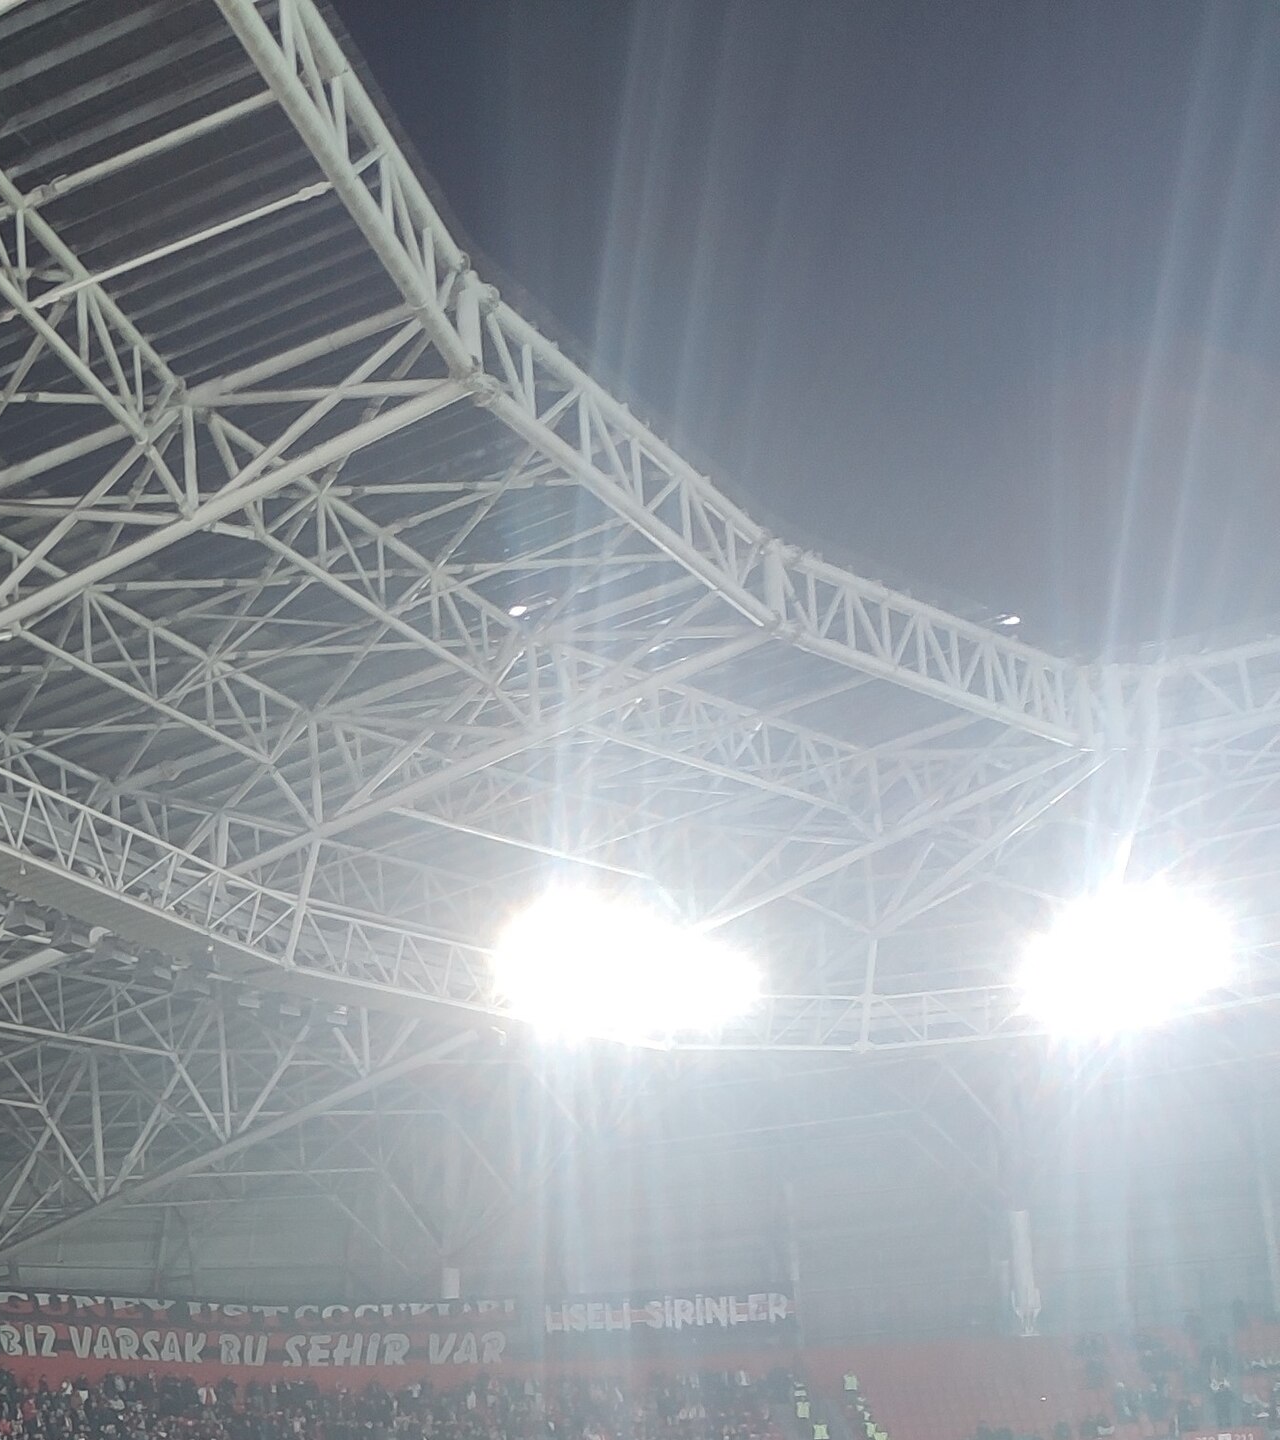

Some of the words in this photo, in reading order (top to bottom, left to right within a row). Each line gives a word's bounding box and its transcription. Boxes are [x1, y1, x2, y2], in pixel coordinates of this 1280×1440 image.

[68, 1326, 207, 1363] VARSAK
[219, 1333, 268, 1367] BU
[429, 1331, 507, 1365] VAR
